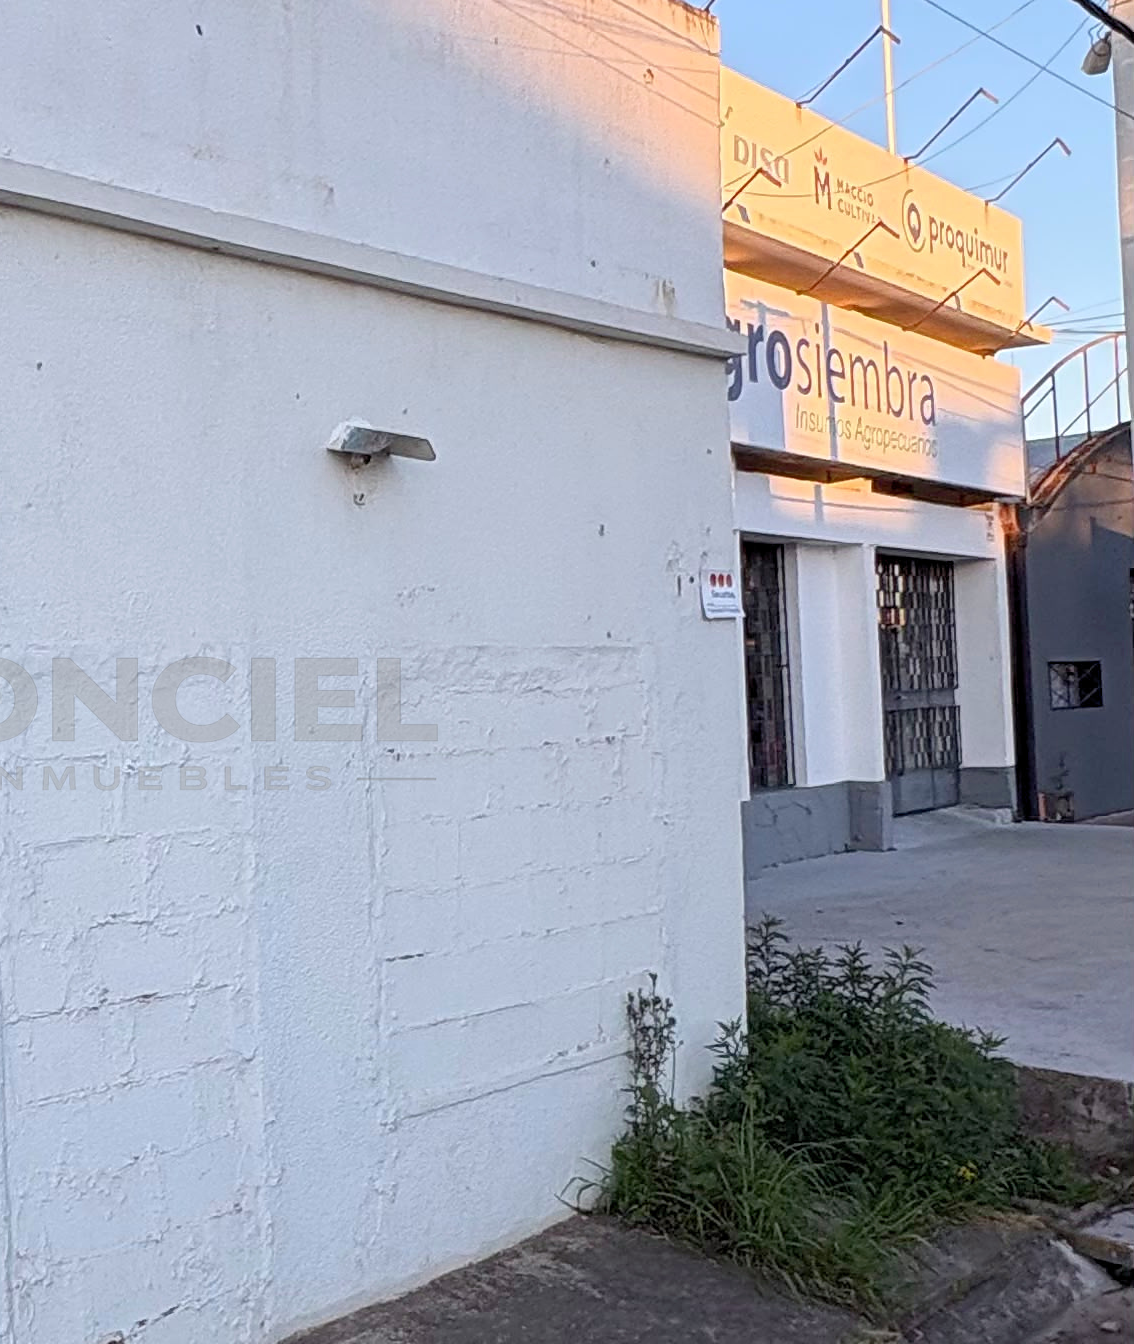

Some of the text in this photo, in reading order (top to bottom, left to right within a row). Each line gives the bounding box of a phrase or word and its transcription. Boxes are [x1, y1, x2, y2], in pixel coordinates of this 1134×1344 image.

[836, 178, 874, 207] MACCIO
[837, 198, 881, 225] CULTIVA
[928, 215, 1008, 274] proquimur
[795, 402, 939, 458] Insumos Agropecuarios
